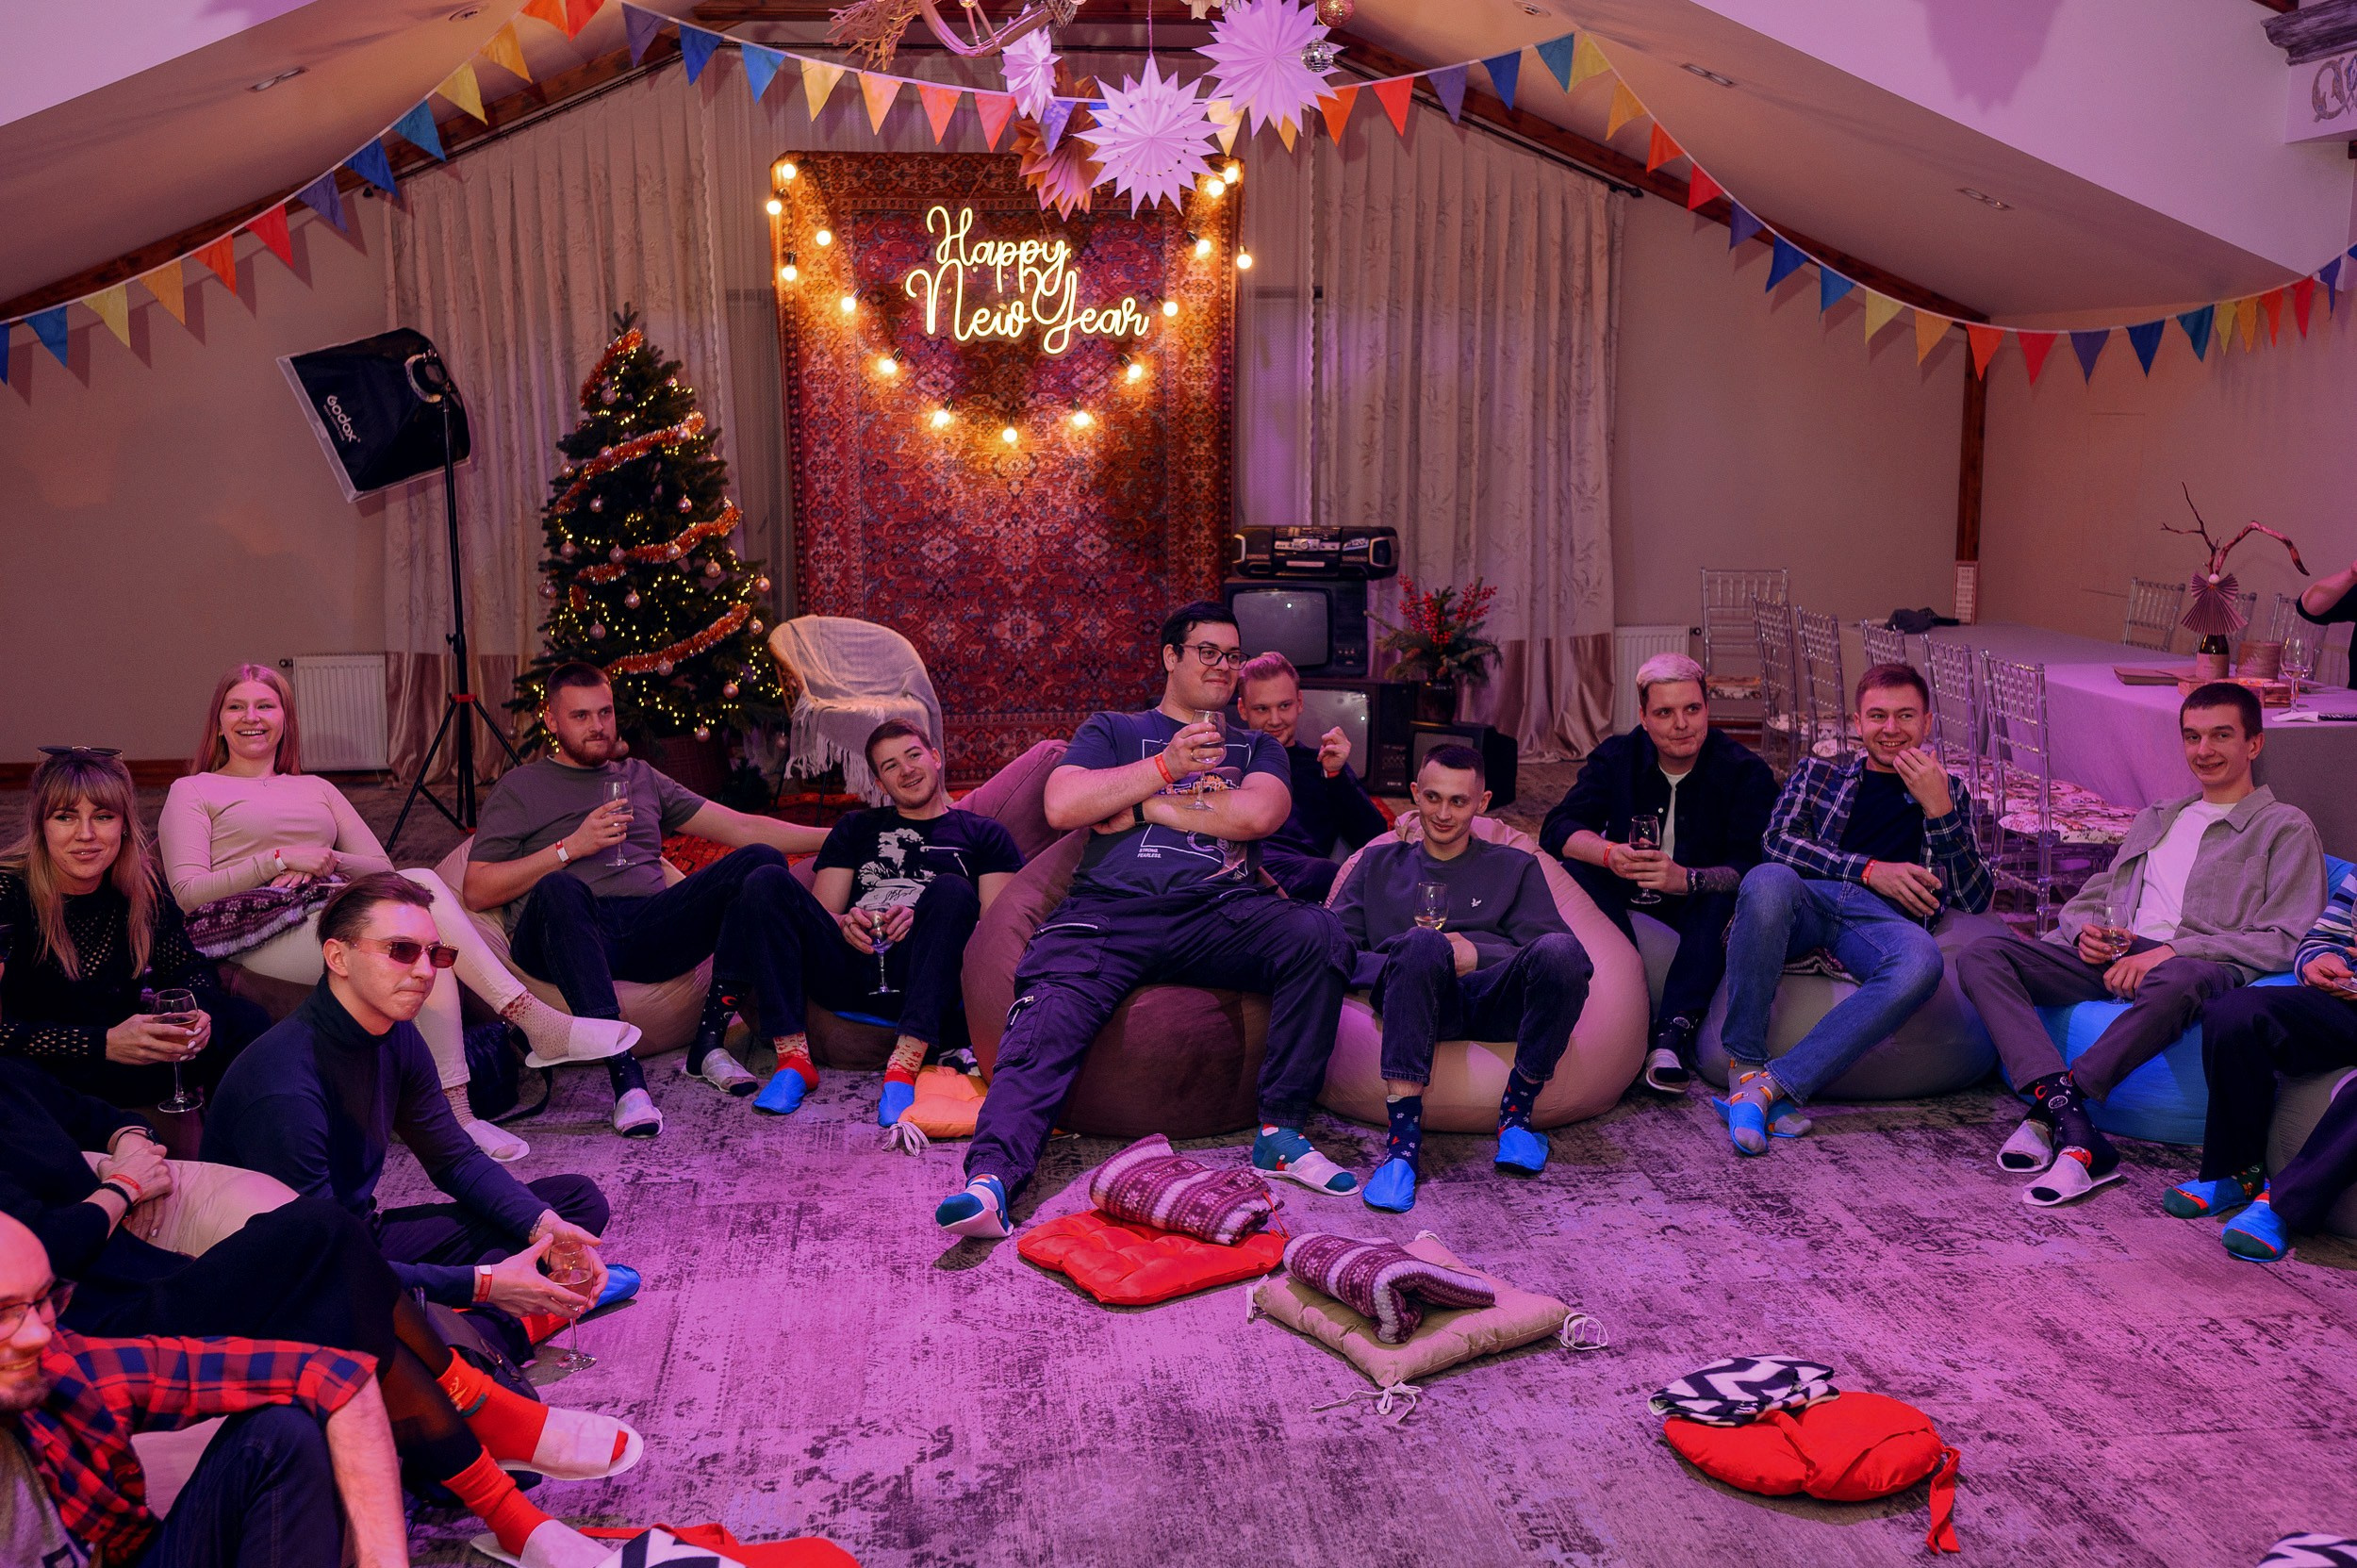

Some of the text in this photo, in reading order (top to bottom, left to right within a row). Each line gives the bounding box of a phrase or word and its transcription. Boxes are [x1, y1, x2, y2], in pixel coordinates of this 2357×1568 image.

[926, 205, 1071, 297] Happy
[905, 257, 1150, 355] New Year
[326, 394, 357, 443] Godox
